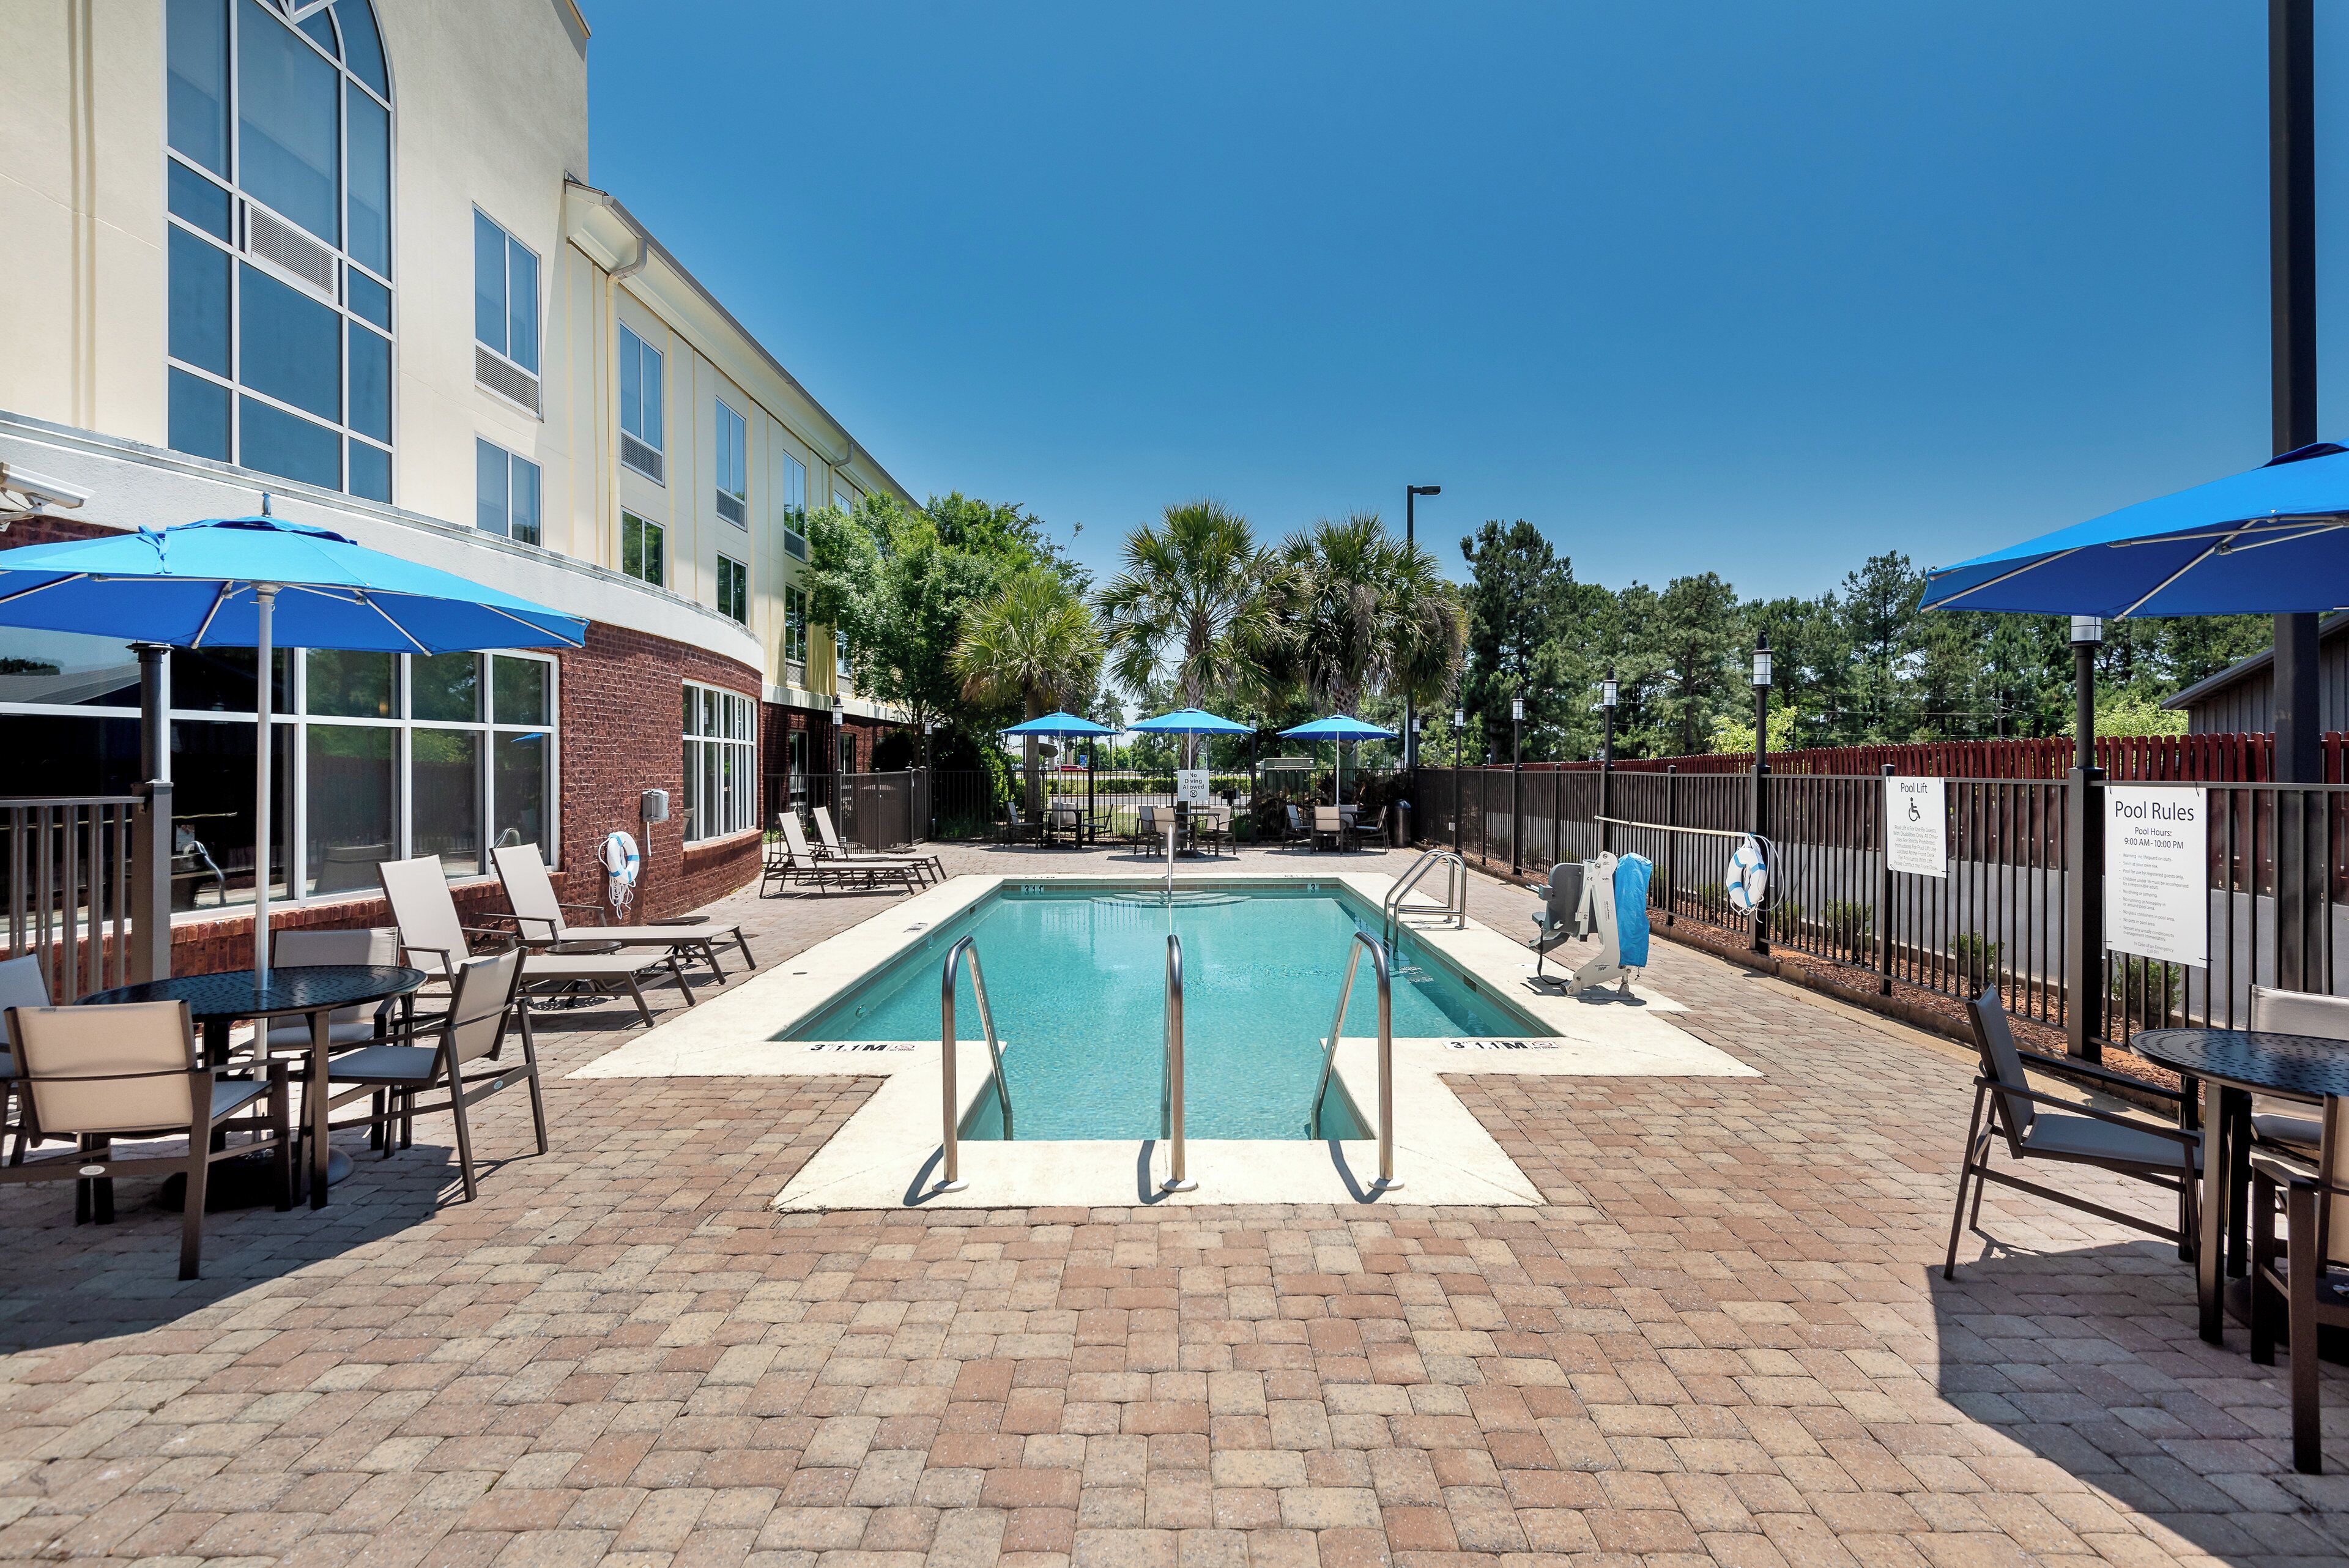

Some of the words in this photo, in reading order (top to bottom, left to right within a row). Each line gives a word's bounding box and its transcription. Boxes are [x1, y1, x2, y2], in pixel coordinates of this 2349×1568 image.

[1901, 783, 1915, 792] Pool
[1917, 783, 1927, 793] Lift
[2116, 801, 2146, 818] Pool
[2152, 802, 2194, 821] Rules
[2151, 828, 2172, 837] Hours:
[2154, 840, 2171, 848] 10:00
